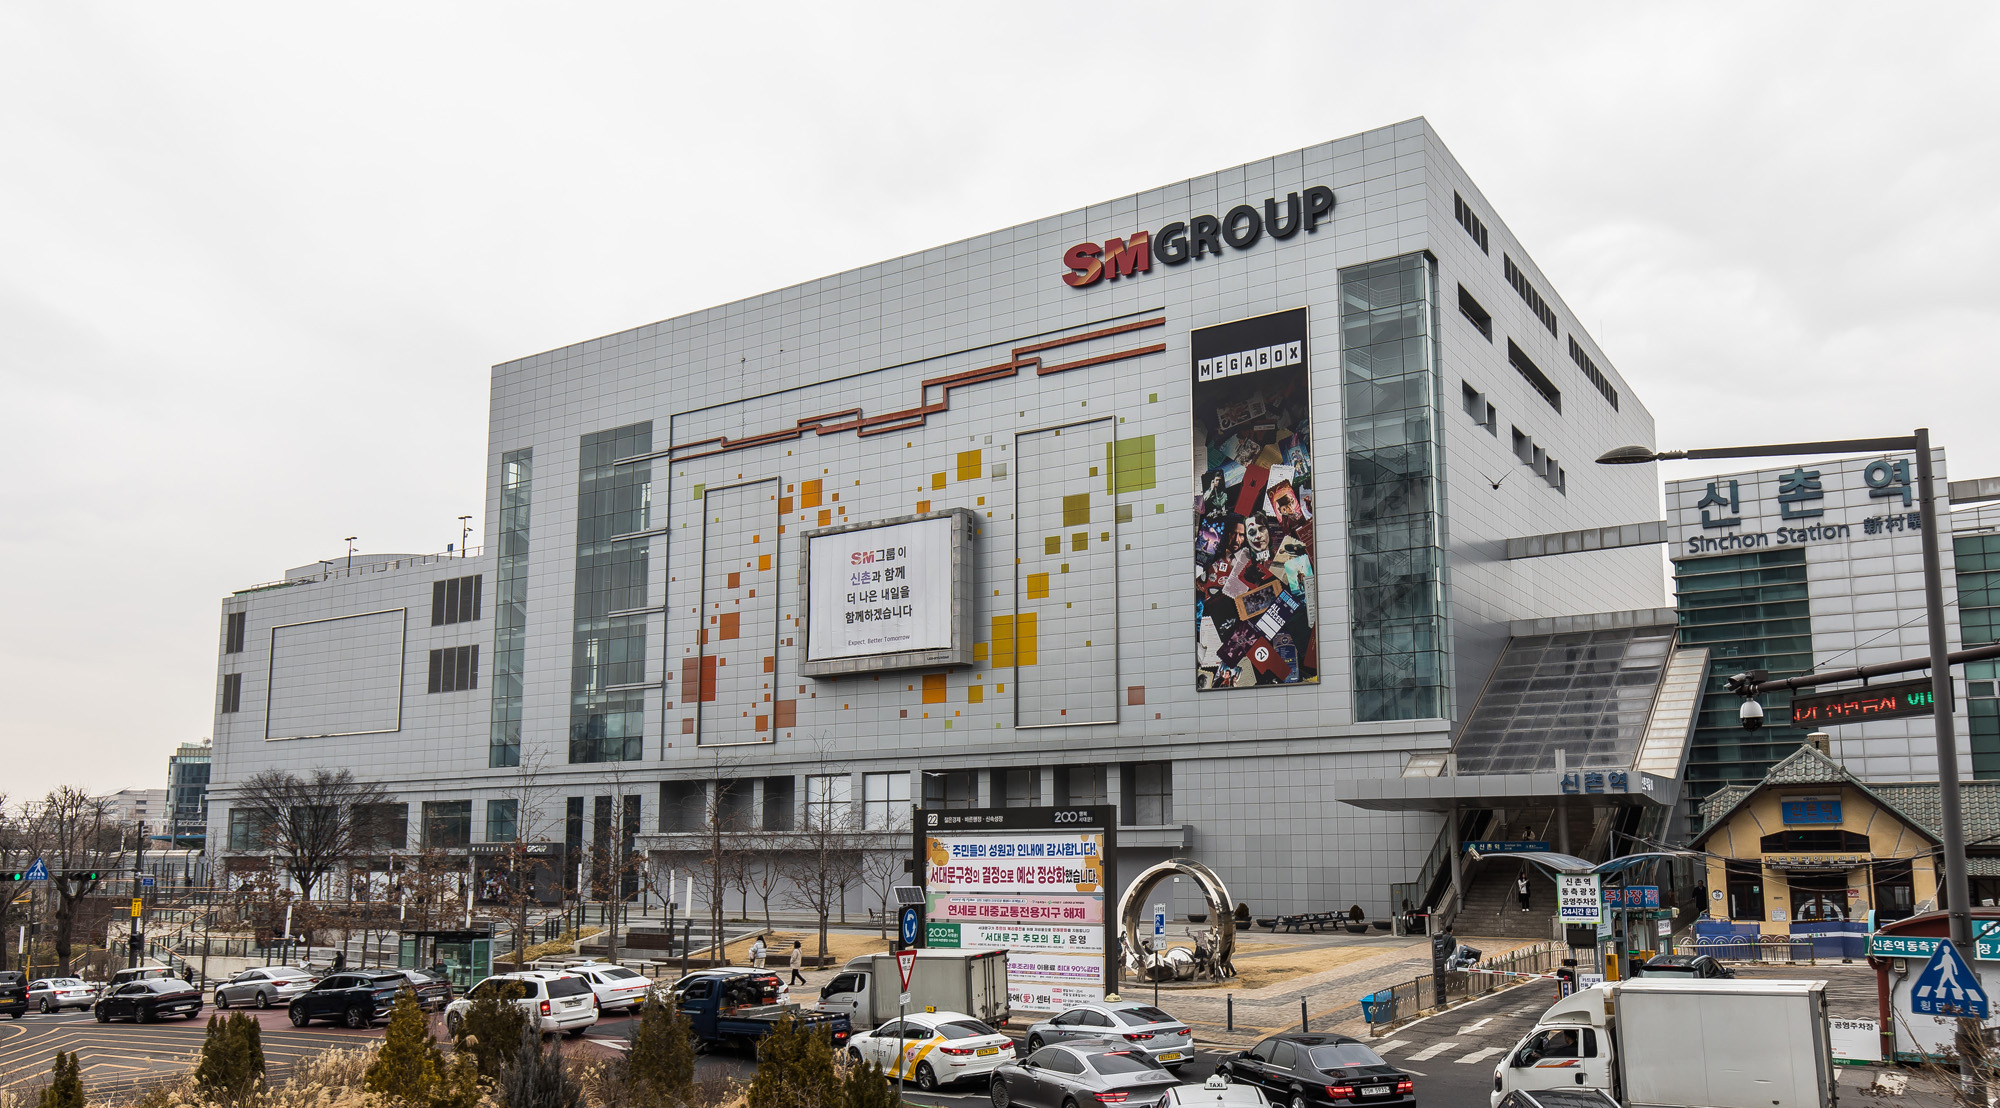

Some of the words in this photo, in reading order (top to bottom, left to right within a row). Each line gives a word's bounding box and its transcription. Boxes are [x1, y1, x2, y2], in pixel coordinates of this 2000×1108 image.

[1199, 344, 1300, 379] MEGABOX
[1697, 458, 1913, 529] 신촌역
[1688, 532, 1768, 553] Sinchon
[1776, 522, 1850, 544] Station
[850, 570, 881, 586] 신촌과
[884, 565, 906, 582] 함께
[847, 592, 856, 604] 더
[859, 589, 878, 603] 나은
[881, 585, 910, 600] 내일을
[845, 604, 913, 624] 함께하겠습니다
[1270, 603, 1281, 613] ALL
[1266, 608, 1286, 627] ACCESS
[884, 634, 911, 642] Tomorrow
[1560, 771, 1628, 794] 신촌역
[1791, 803, 1833, 816] 신촌역
[928, 814, 938, 824] 22
[1054, 811, 1078, 823] 200
[952, 844, 986, 857] 주민들의
[988, 843, 1015, 857] 성원과
[1017, 843, 1045, 857] 인내에
[1046, 842, 1096, 857] 감사합니다!
[930, 866, 980, 884] 서대문구청의
[982, 866, 1014, 884] 결정으로
[1016, 866, 1036, 884] 예산
[1037, 866, 1098, 884] 정상화했습니다.
[1565, 878, 1591, 886] 신촌역
[1561, 888, 1596, 896] 동측광장
[1604, 889, 1643, 904] 주차장
[1562, 898, 1597, 906] 공영주차장
[947, 904, 977, 916] 연세로
[979, 905, 1061, 918] 대중교통전용지구
[1063, 907, 1086, 919] 해제
[1562, 908, 1585, 916] 24시간
[1585, 908, 1598, 916] 운영
[928, 928, 948, 937] 200
[980, 932, 1019, 942] 「서대문구
[1023, 934, 1049, 943] 추모의
[1052, 934, 1066, 944] 집」
[1069, 935, 1086, 944] 운영
[1036, 994, 1051, 1004] 센터
[1834, 1021, 1874, 1030] 공영주차장
